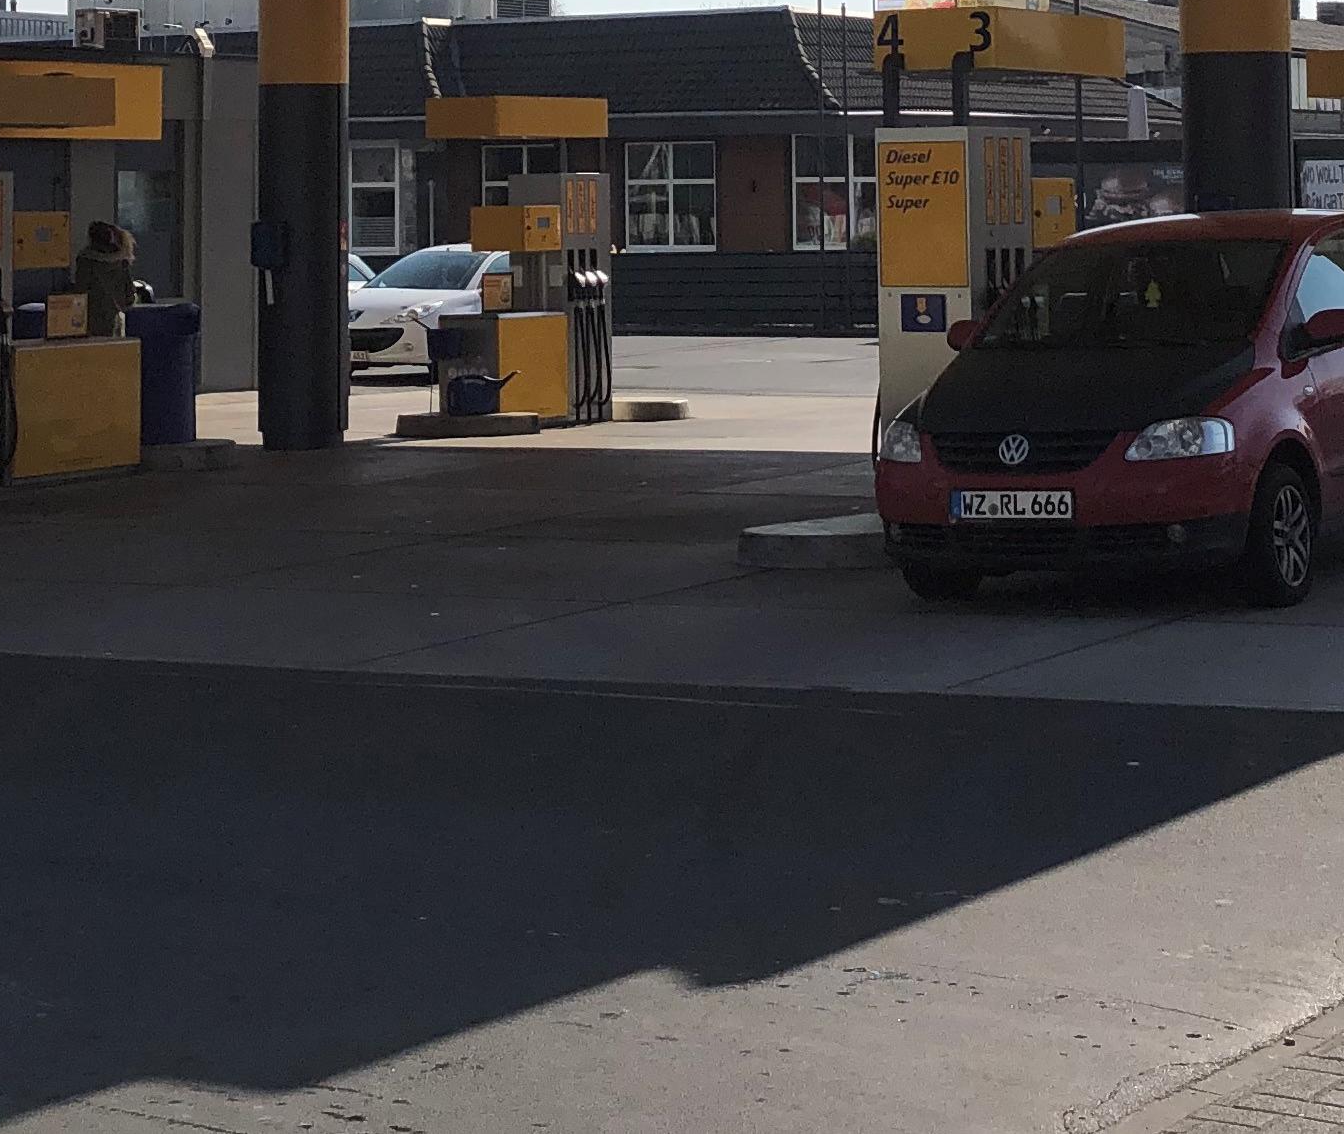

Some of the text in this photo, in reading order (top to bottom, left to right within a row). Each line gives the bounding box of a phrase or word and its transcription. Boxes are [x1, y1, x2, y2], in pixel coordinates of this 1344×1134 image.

[877, 13, 904, 54] 4
[970, 11, 992, 51] 3
[885, 148, 932, 165] Diesel
[885, 169, 960, 191] Super E10
[886, 194, 930, 214] Super
[962, 493, 1070, 516] WZ RL 666
